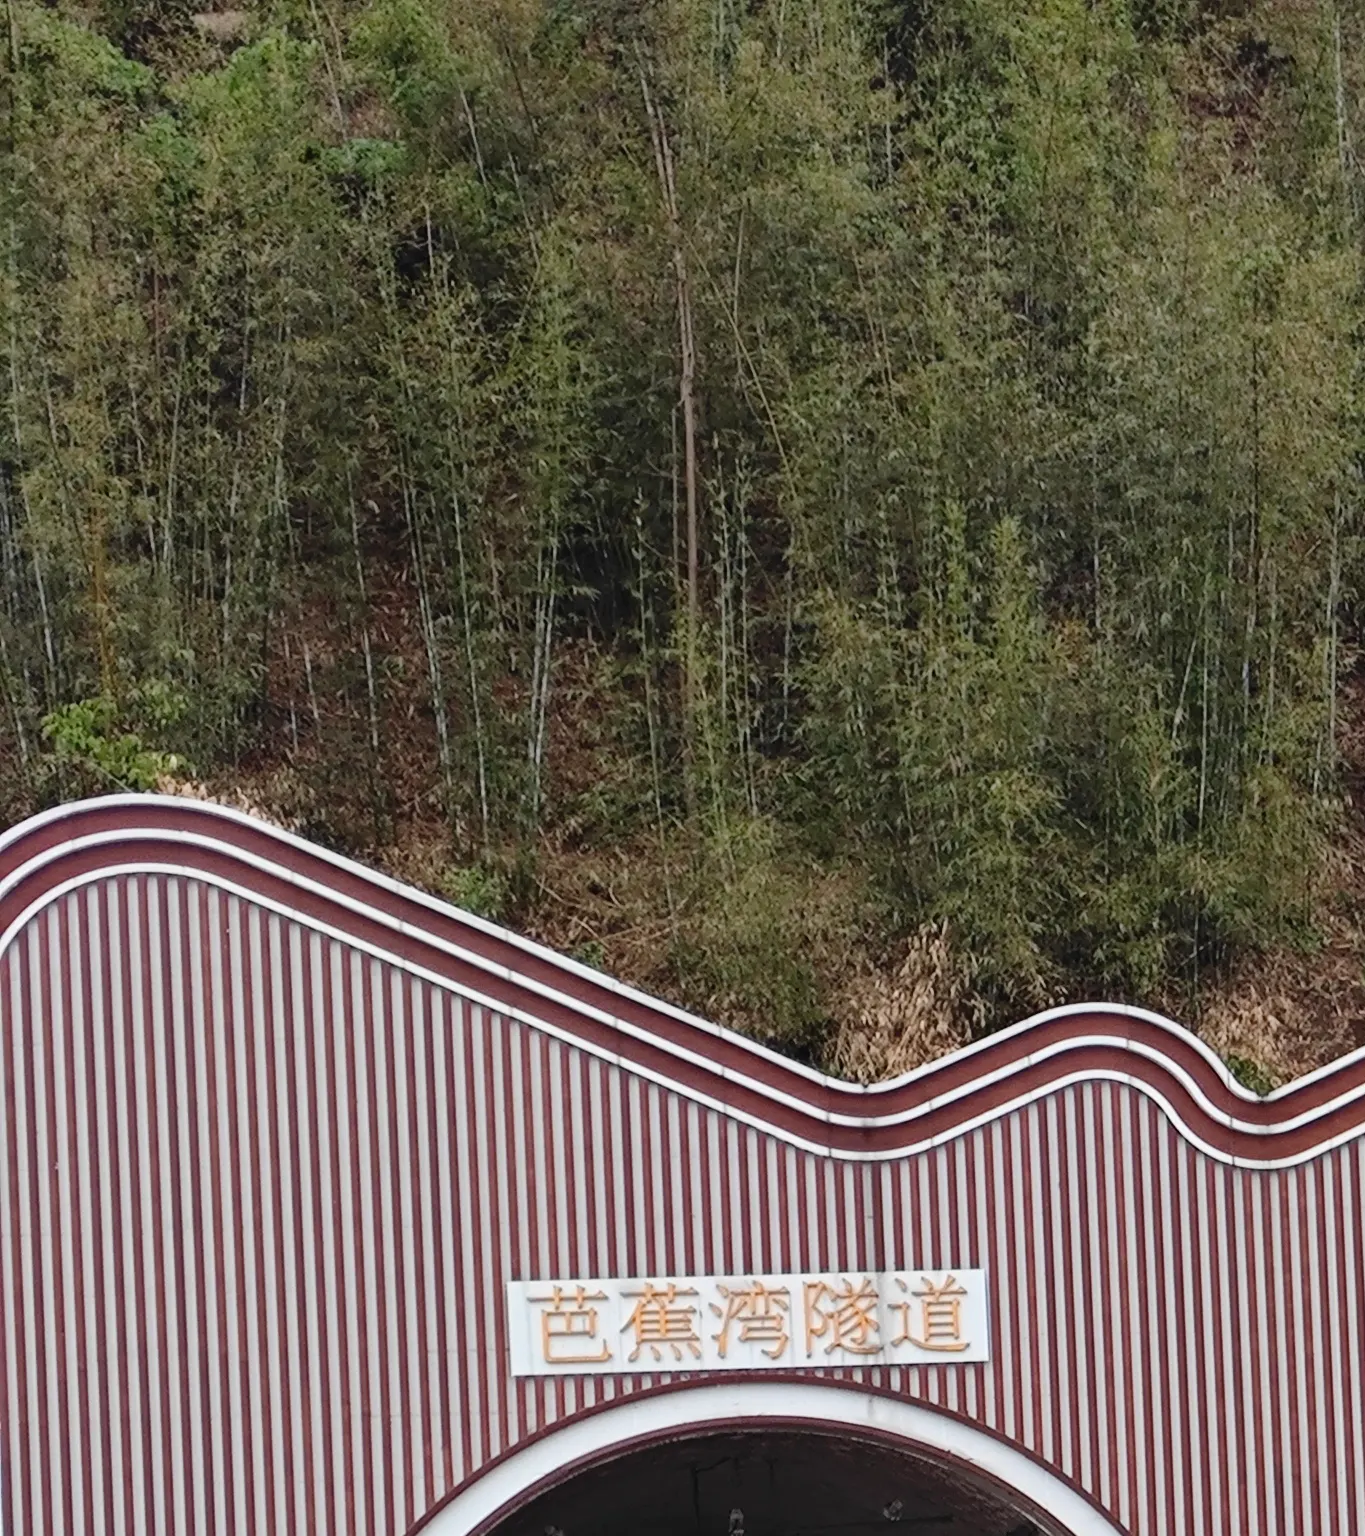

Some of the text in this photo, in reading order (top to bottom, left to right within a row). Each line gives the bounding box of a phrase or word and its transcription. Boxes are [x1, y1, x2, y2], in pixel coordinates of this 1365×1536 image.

[527, 1275, 970, 1364] 芭蕉湾隧道
